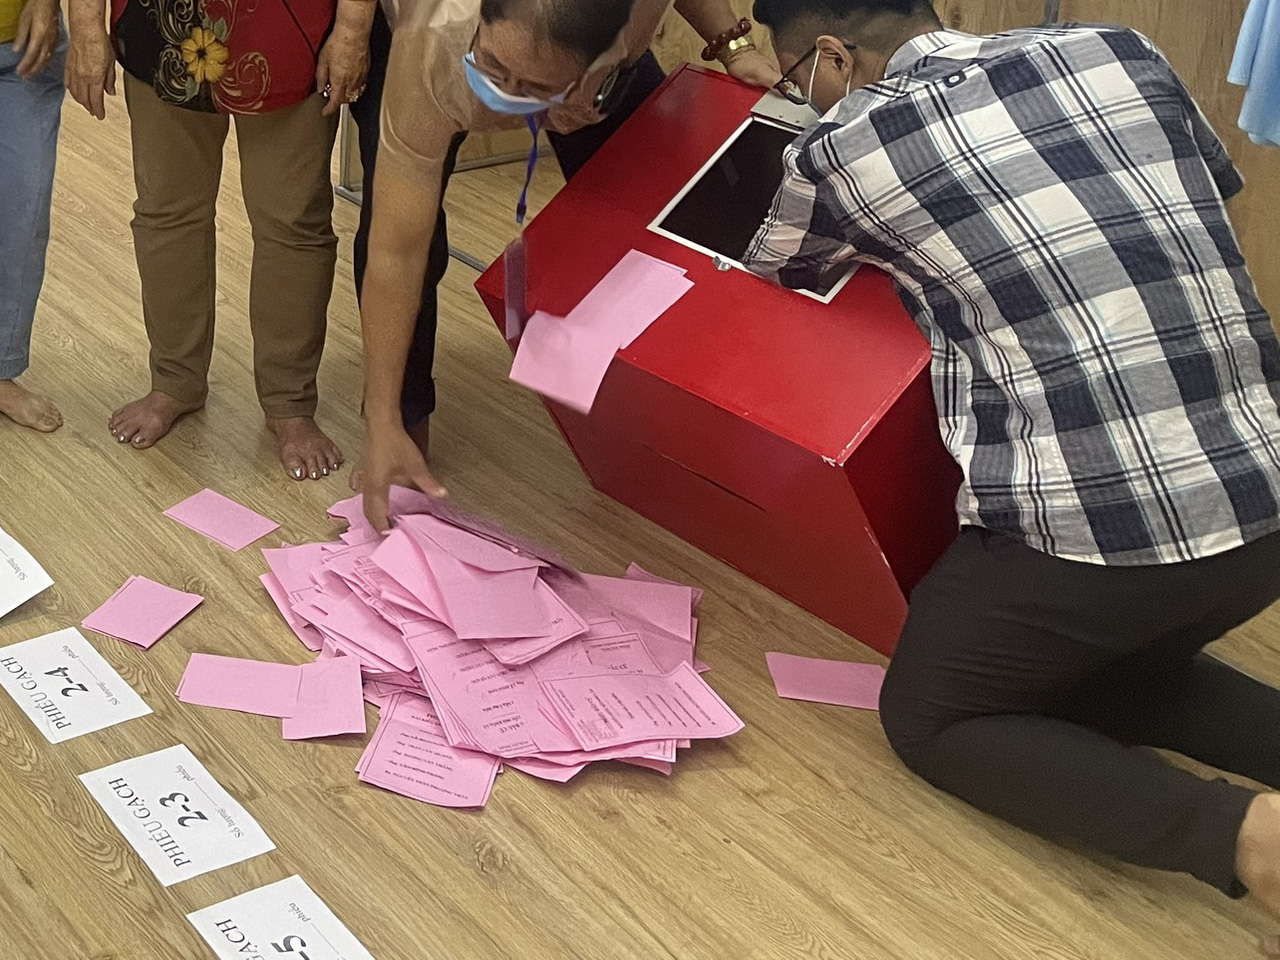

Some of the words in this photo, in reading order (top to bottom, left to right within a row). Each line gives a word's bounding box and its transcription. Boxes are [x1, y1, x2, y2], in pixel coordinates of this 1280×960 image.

[0, 657, 37, 690] GẠCH
[44, 667, 90, 697] 2-4
[30, 692, 72, 729] PHIẾU
[108, 778, 151, 819] GẠCH
[159, 793, 209, 827] 2-3
[143, 821, 192, 867] PHIẾU
